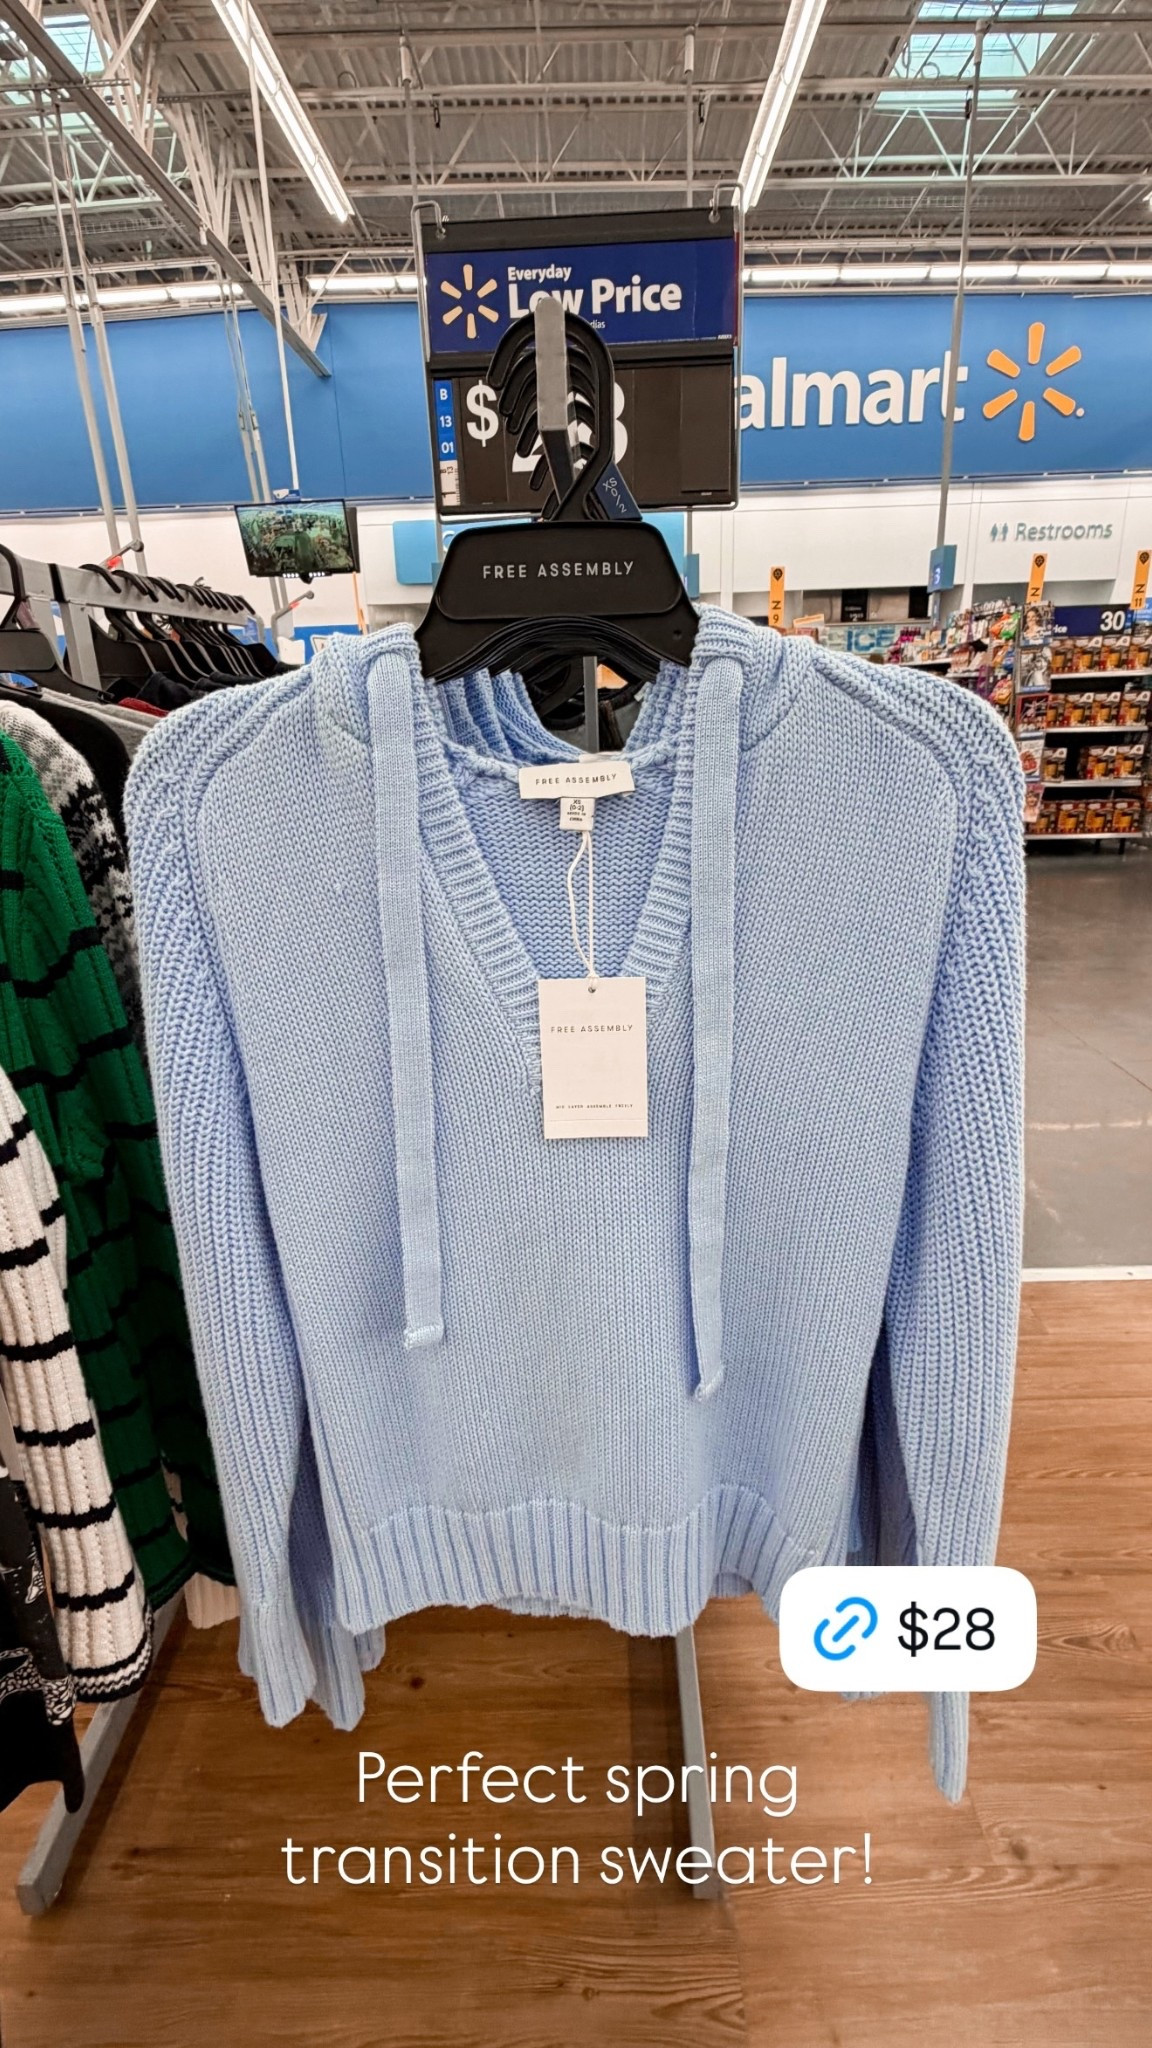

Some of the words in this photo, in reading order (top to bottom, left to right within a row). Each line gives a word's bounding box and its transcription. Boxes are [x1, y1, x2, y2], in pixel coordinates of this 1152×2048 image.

[507, 264, 572, 283] Everyday
[592, 275, 682, 314] Price
[440, 389, 448, 400] B
[734, 350, 969, 430] almart
[440, 416, 453, 428] 13
[441, 442, 454, 454] 01
[602, 477, 618, 491] XS
[1014, 521, 1113, 541] Restrooms
[483, 564, 527, 579] FREE
[537, 561, 634, 578] ASSEMBLY
[1100, 610, 1126, 631] 30
[846, 627, 896, 652] ICE
[535, 777, 560, 785] FREE
[565, 773, 617, 784] ASSEMBLY
[550, 1026, 576, 1034] FREE
[580, 1024, 633, 1033] ASSEMBLY
